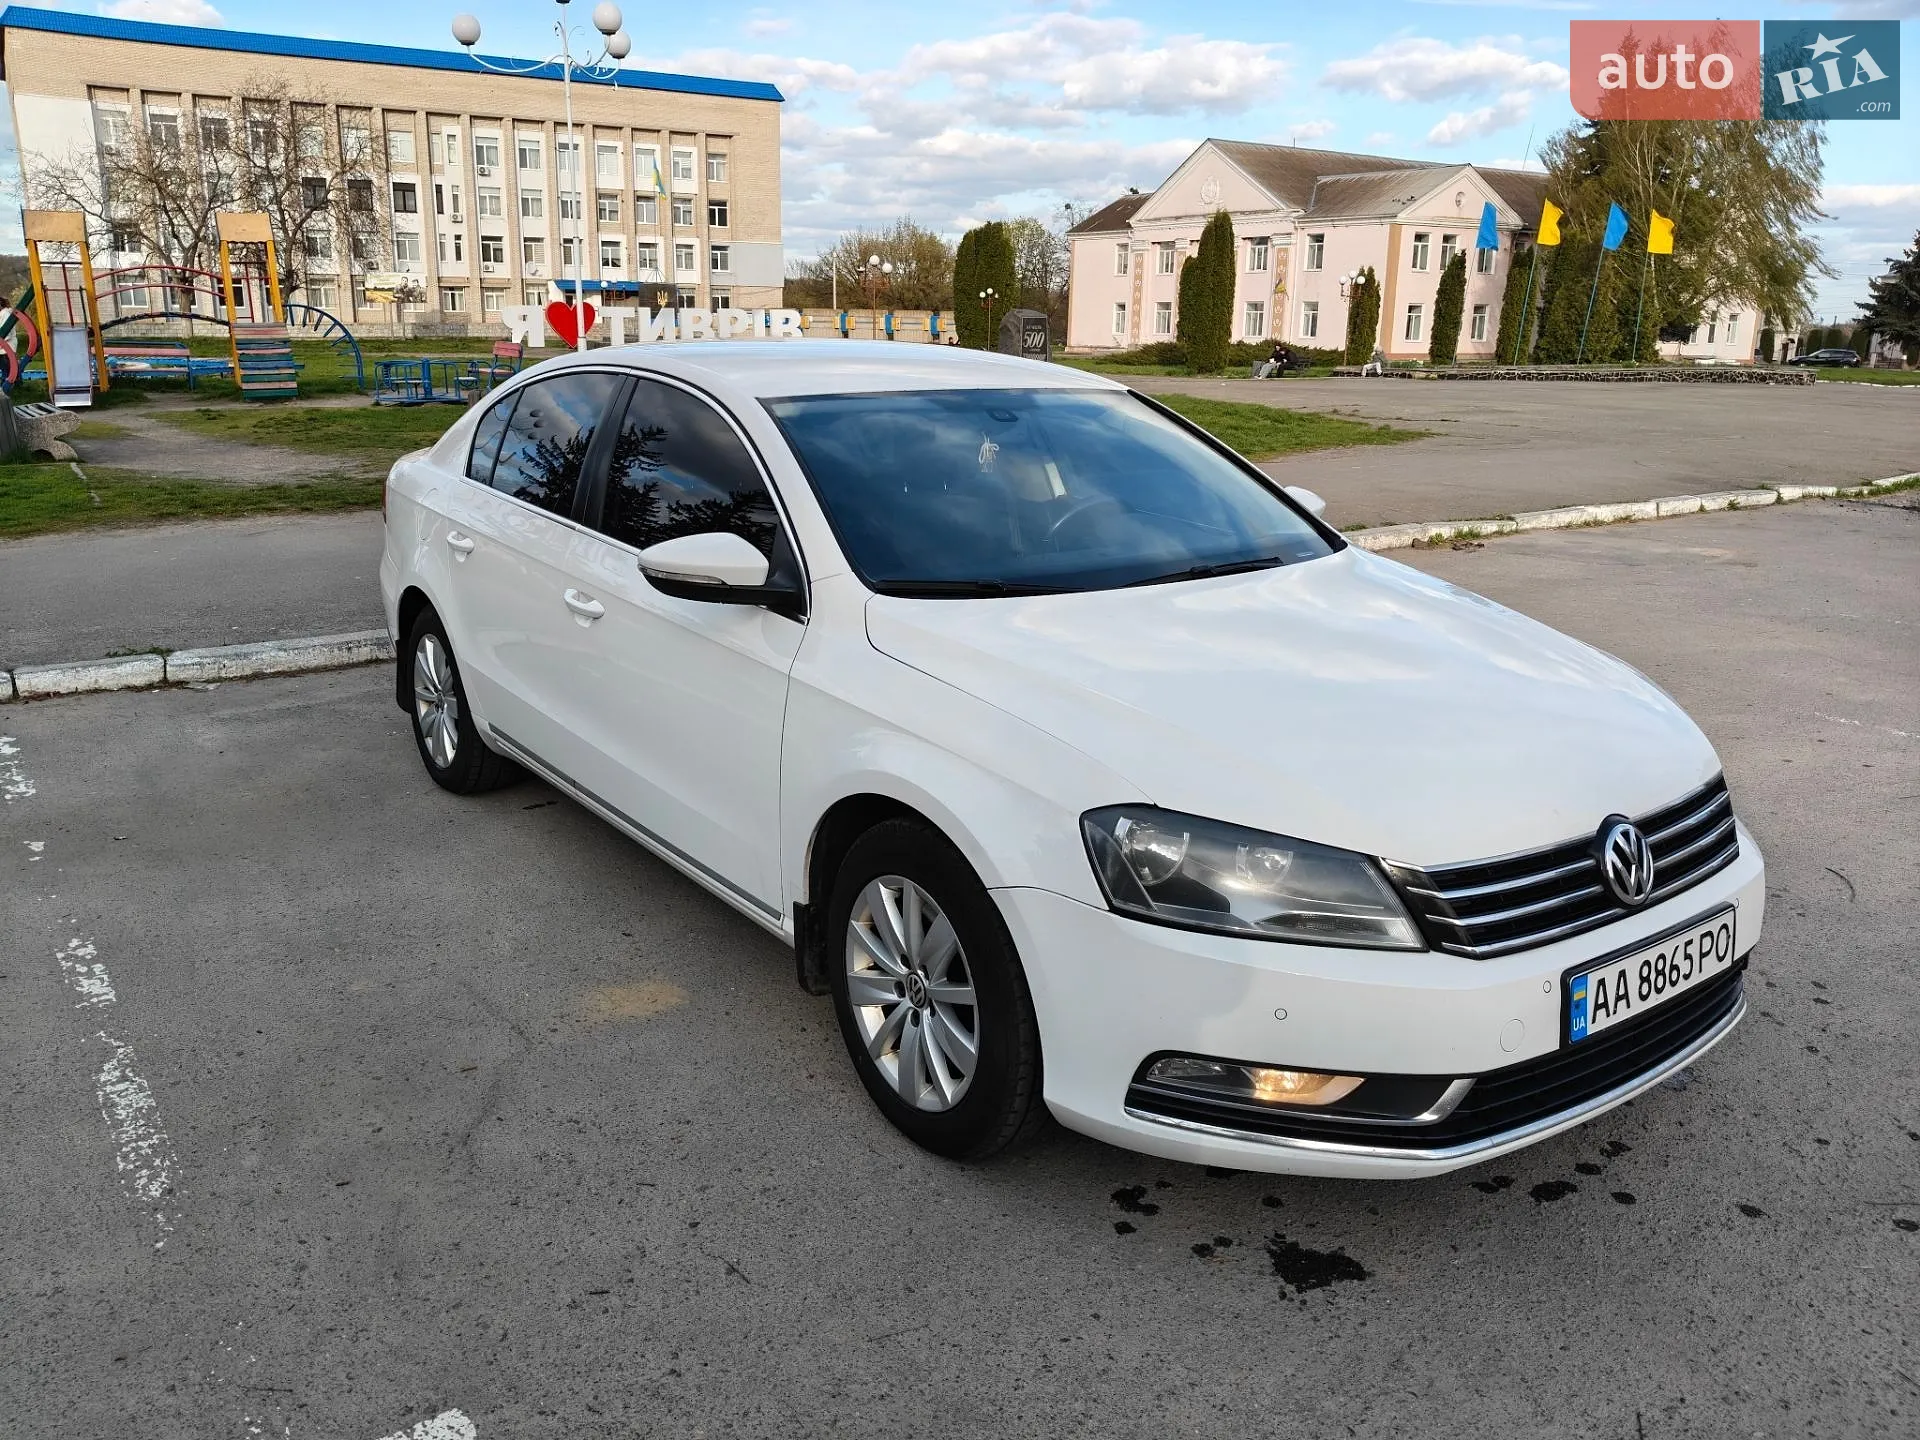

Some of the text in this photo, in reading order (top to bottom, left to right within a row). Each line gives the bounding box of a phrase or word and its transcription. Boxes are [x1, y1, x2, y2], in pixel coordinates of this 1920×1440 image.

[501, 305, 804, 347] Я ТИВРІВ
[1023, 331, 1045, 348] 500
[1591, 922, 1731, 1025] AA 8865 PO
[1573, 1015, 1586, 1031] UA
